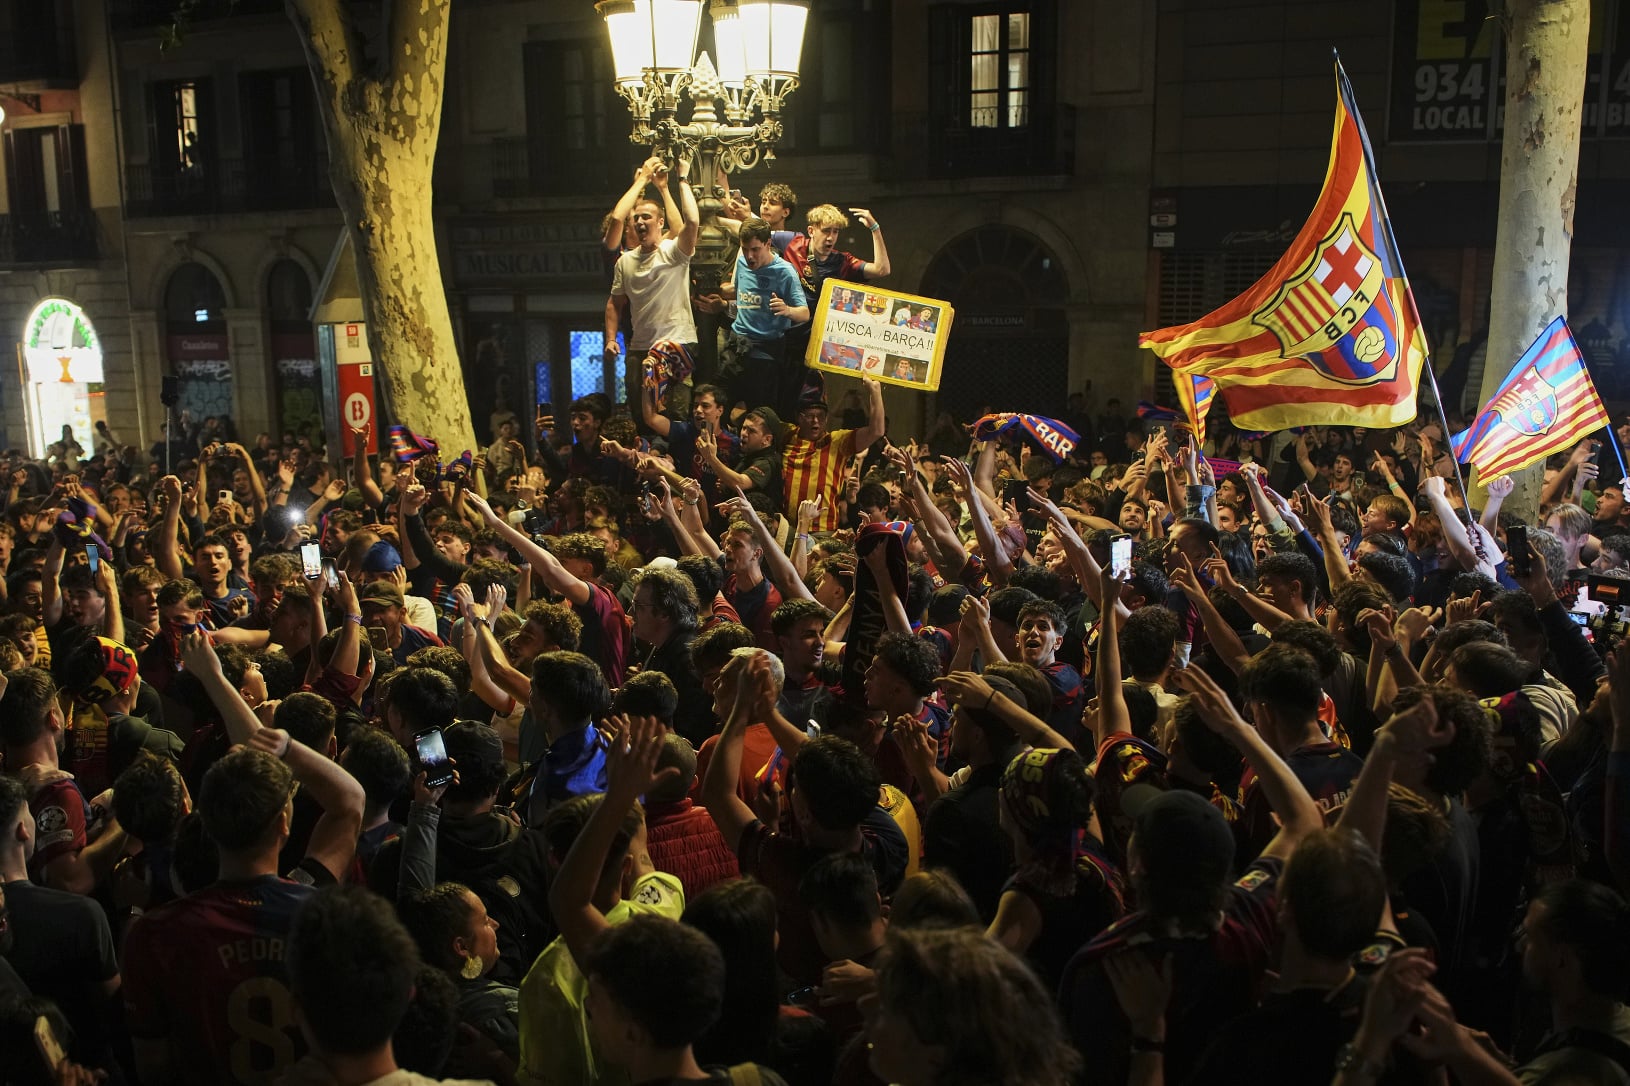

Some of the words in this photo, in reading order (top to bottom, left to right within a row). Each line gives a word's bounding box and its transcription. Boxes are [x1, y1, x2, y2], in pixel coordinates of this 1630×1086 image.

[1415, 64, 1485, 102] 934
[1413, 105, 1484, 130] LOCAL
[466, 253, 556, 273] MUSICAL
[351, 400, 364, 421] B
